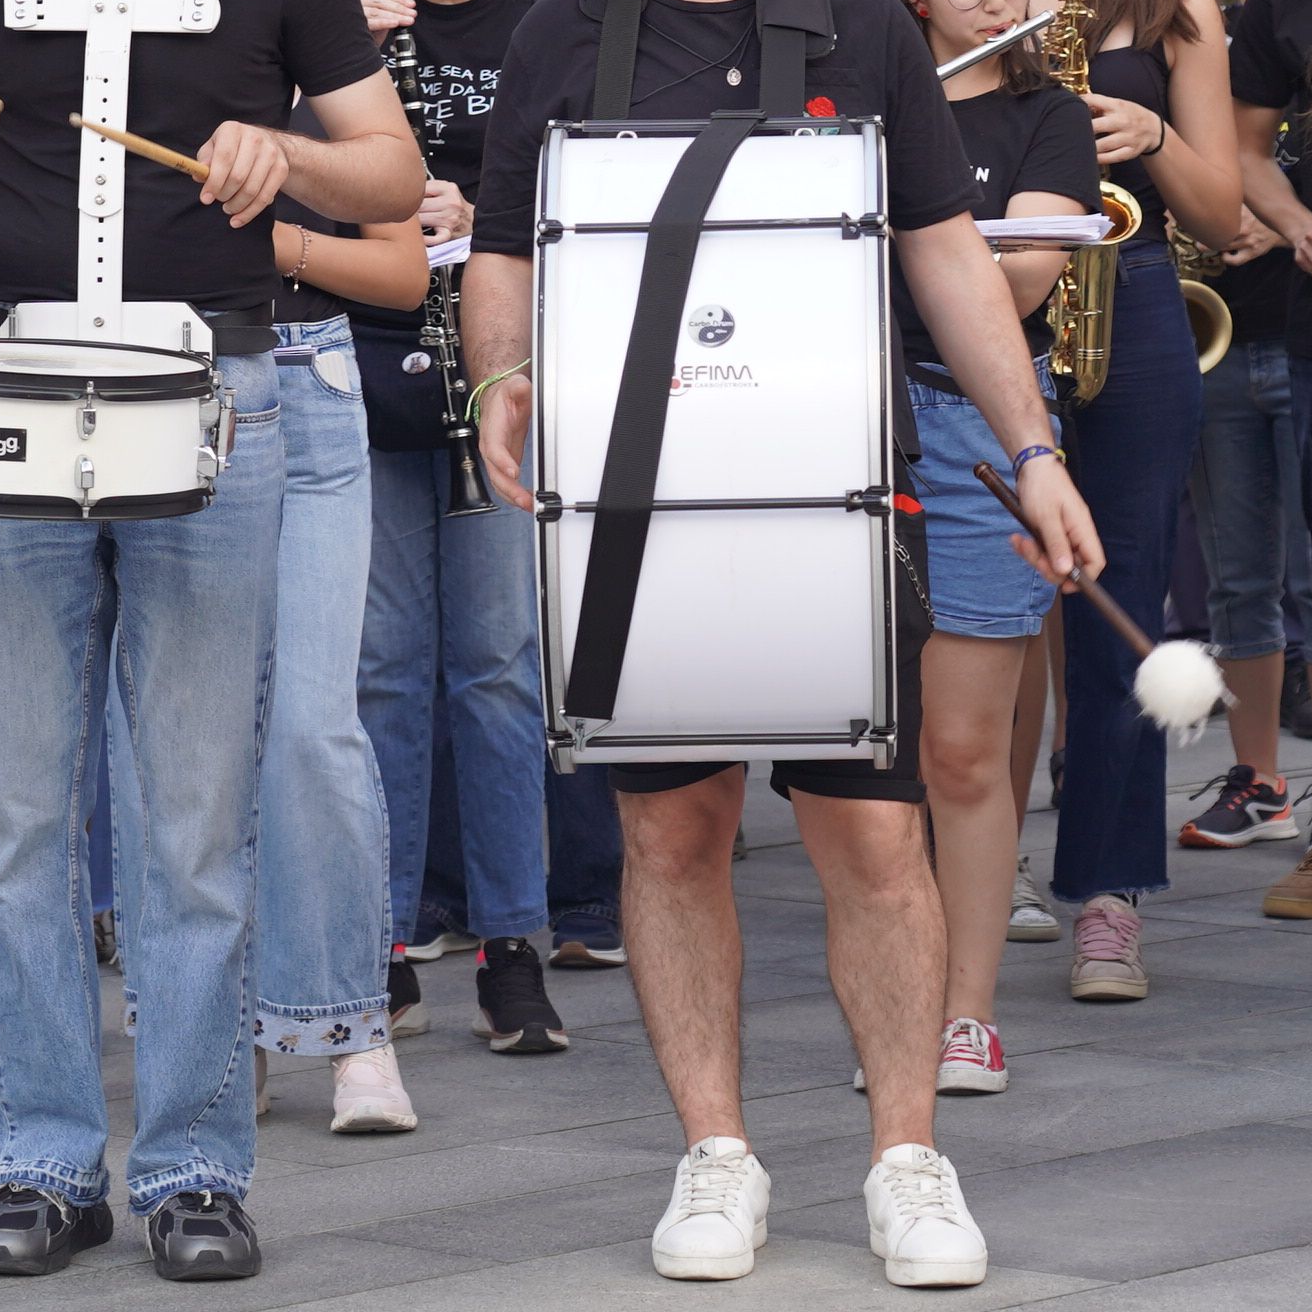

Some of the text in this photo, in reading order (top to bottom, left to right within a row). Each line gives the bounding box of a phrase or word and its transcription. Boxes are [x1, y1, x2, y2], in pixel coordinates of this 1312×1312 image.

[439, 65, 474, 81] SEA
[479, 68, 502, 81] BO
[449, 83, 476, 96] DA
[680, 364, 753, 381] EFIMA
